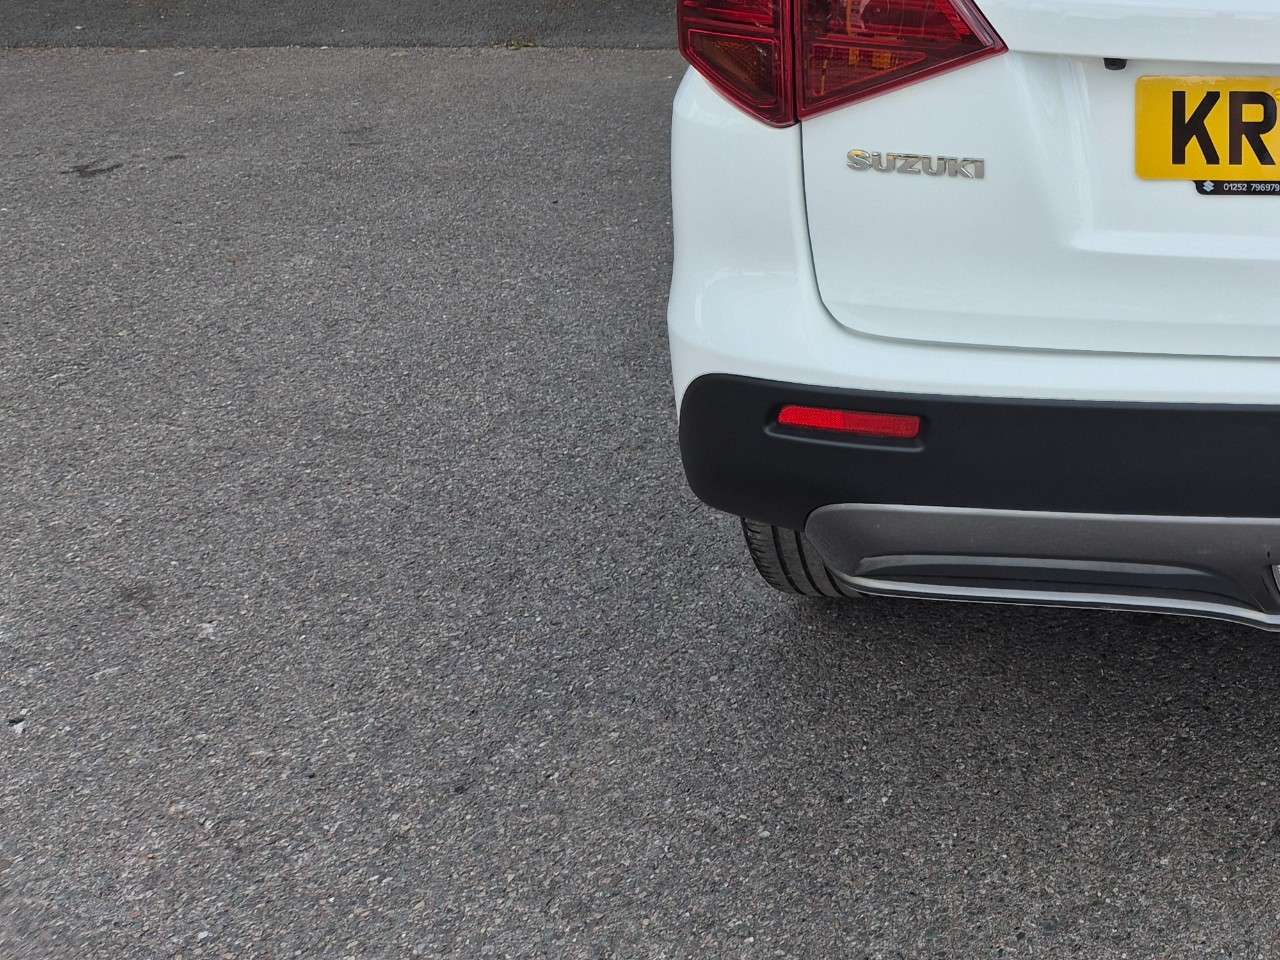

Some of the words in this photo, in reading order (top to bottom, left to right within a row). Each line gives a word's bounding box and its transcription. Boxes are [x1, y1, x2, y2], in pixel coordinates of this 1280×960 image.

[847, 148, 985, 179] SUZUKI
[1223, 183, 1247, 192] 01252
[1250, 183, 1280, 192] 796979
